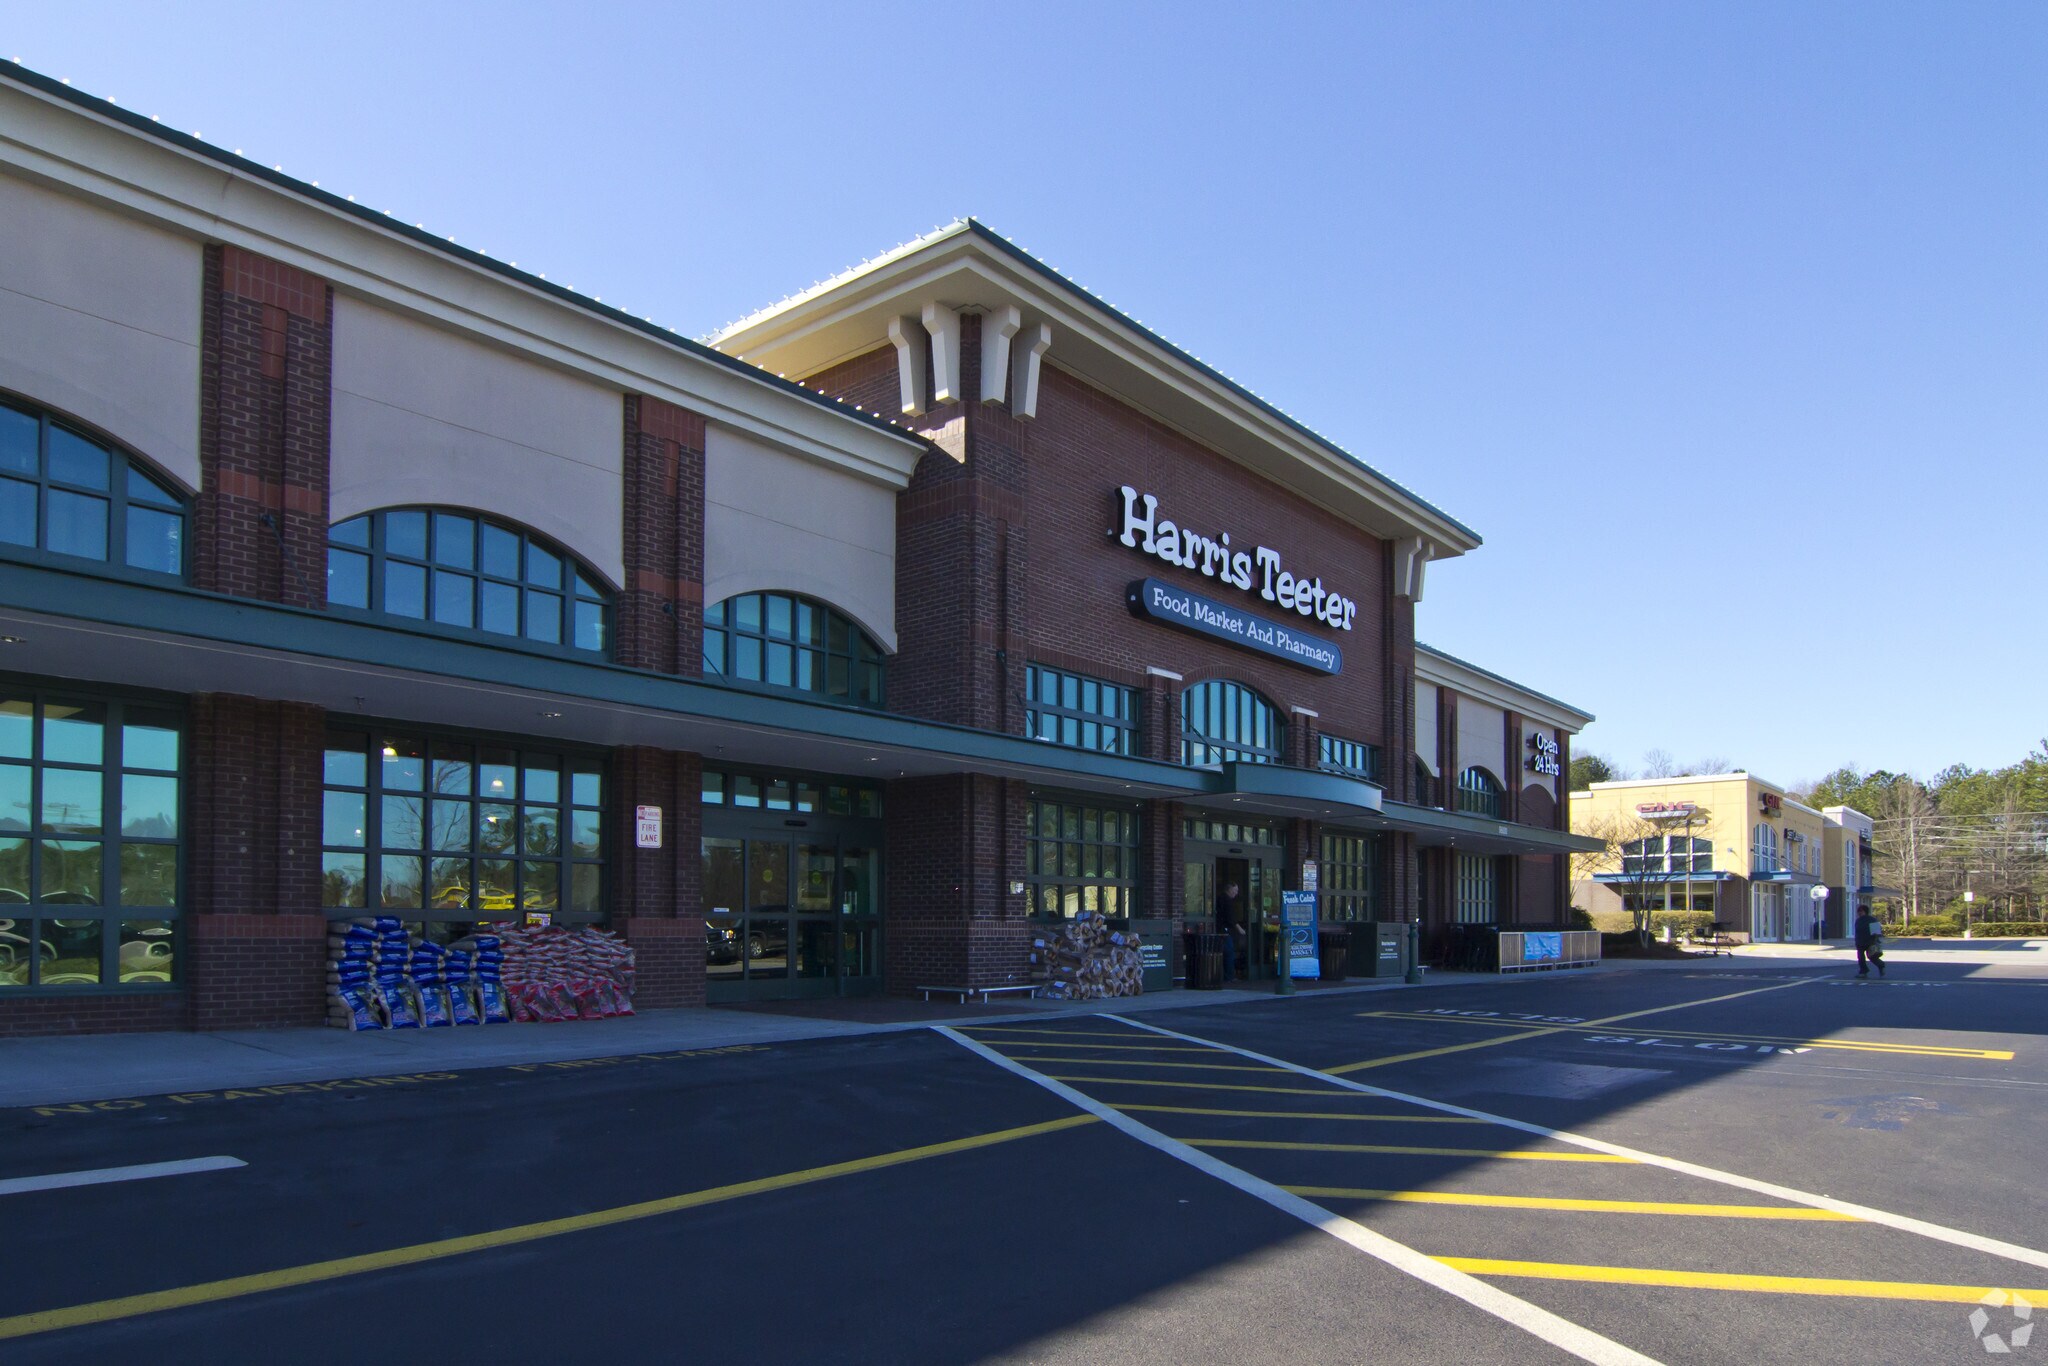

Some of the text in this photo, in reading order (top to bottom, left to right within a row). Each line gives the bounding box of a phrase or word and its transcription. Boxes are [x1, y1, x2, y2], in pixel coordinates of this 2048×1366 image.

[1120, 486, 1356, 630] Harris Teeter
[1153, 587, 1335, 668] Food Market And Pharmacy
[1537, 733, 1558, 755] Open
[1535, 755, 1559, 776] 24 Hrs
[1636, 801, 1695, 812] GNC
[640, 834, 658, 842] LANE
[641, 824, 657, 832] FIRE
[1584, 1036, 1812, 1054] SLOW
[33, 1100, 146, 1116] NO
[167, 1073, 459, 1104] PARKING
